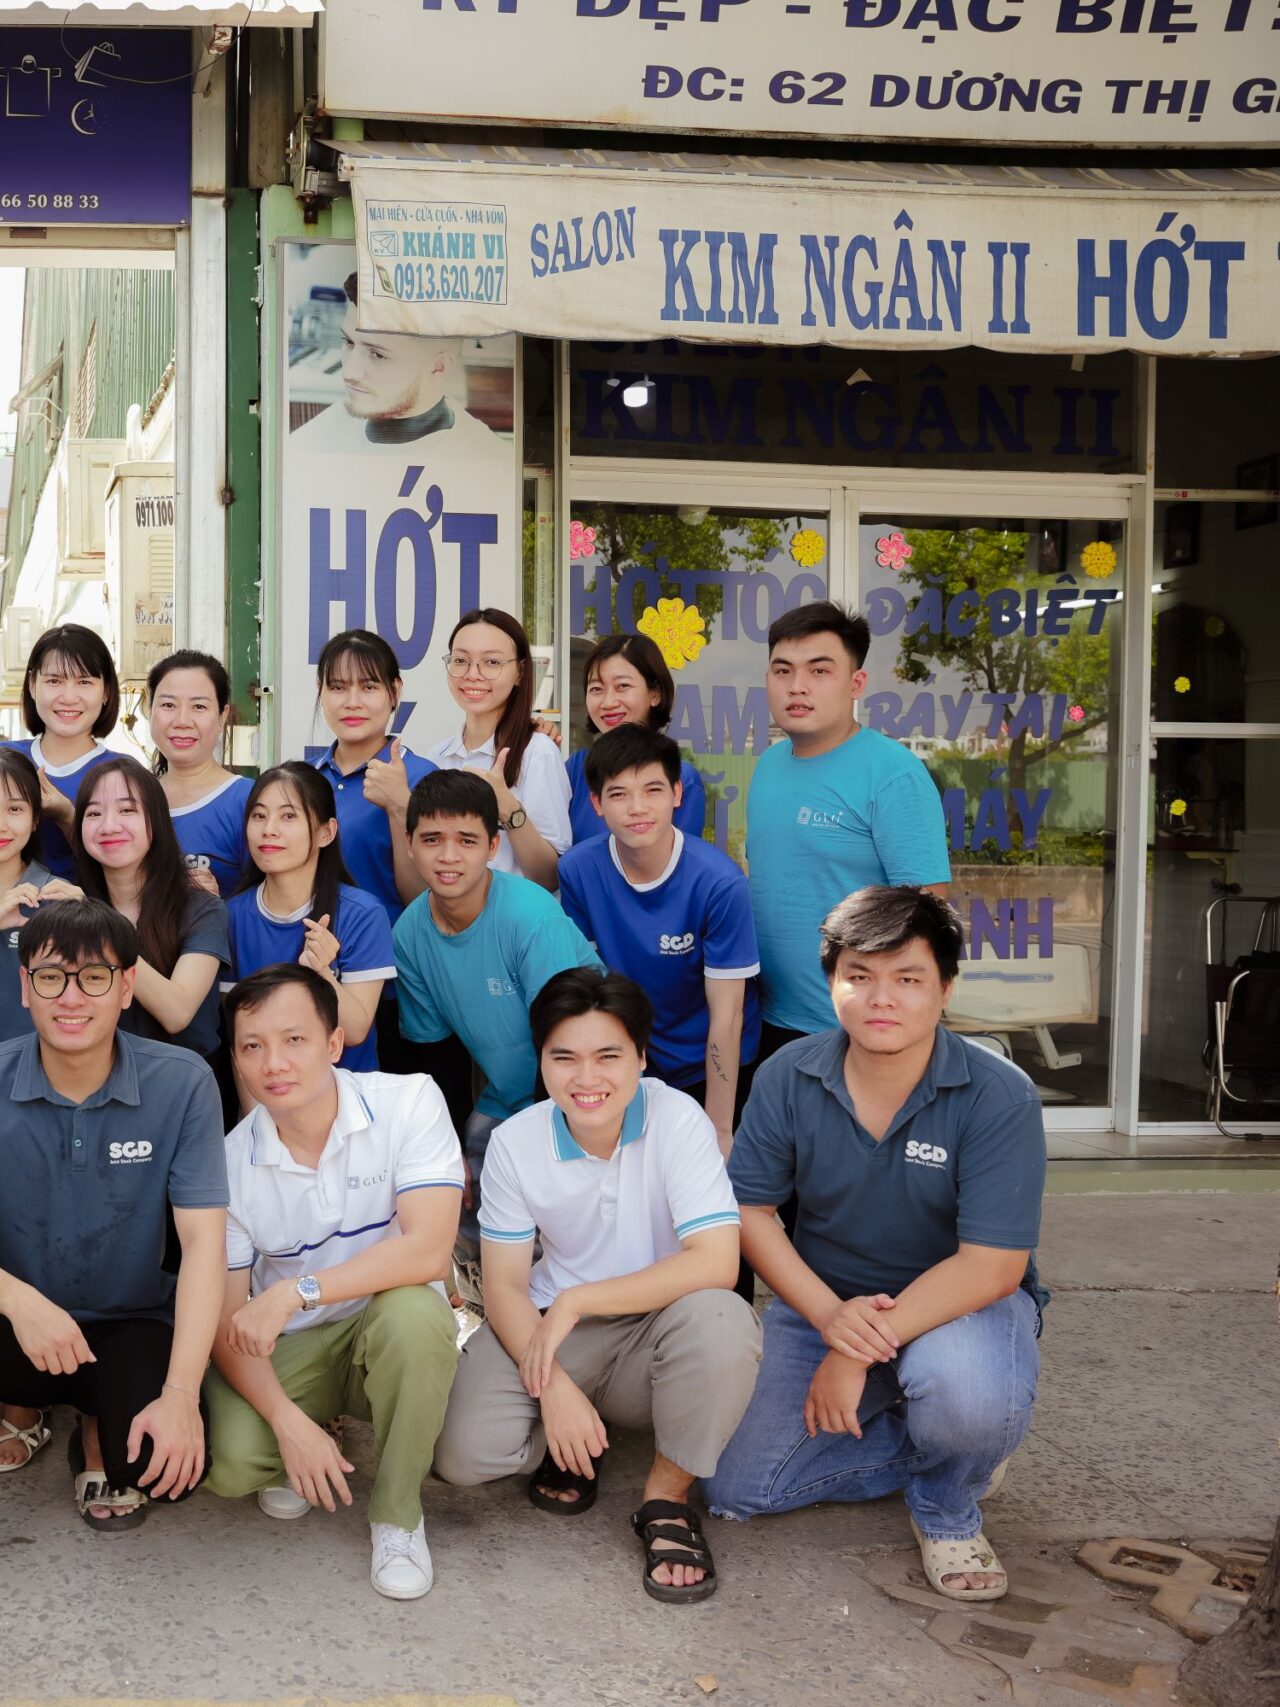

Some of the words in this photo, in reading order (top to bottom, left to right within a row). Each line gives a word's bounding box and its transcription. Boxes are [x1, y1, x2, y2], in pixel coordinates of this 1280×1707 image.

[641, 65, 745, 102] ĐC:
[768, 70, 848, 107] 62
[869, 69, 1083, 115] DƯƠNG
[1105, 79, 1211, 123] THỊ
[1232, 77, 1280, 115] G
[1, 194, 22, 209] 66
[26, 194, 49, 209] 50
[53, 194, 75, 210] 88
[78, 194, 100, 210] 33
[402, 225, 476, 260] KHÁNH
[482, 234, 505, 260] VI
[529, 206, 637, 279] SALON
[393, 262, 505, 302] 0913.620.207
[658, 228, 779, 326] KIM
[799, 208, 967, 333] NGÂN
[986, 241, 1031, 335] II
[1076, 211, 1246, 341] HỚT
[579, 369, 764, 447] KIM
[779, 364, 1033, 454] NGÂN
[1052, 387, 1121, 457] II
[307, 465, 499, 672] HỚT
[864, 573, 982, 644] ĐẶC
[987, 573, 1119, 648] BIỆT
[184, 853, 210, 870] GD
[659, 932, 695, 950] SGD
[109, 1140, 153, 1159] SGD
[904, 1140, 948, 1163] SGD
[362, 1173, 386, 1187] GLU
